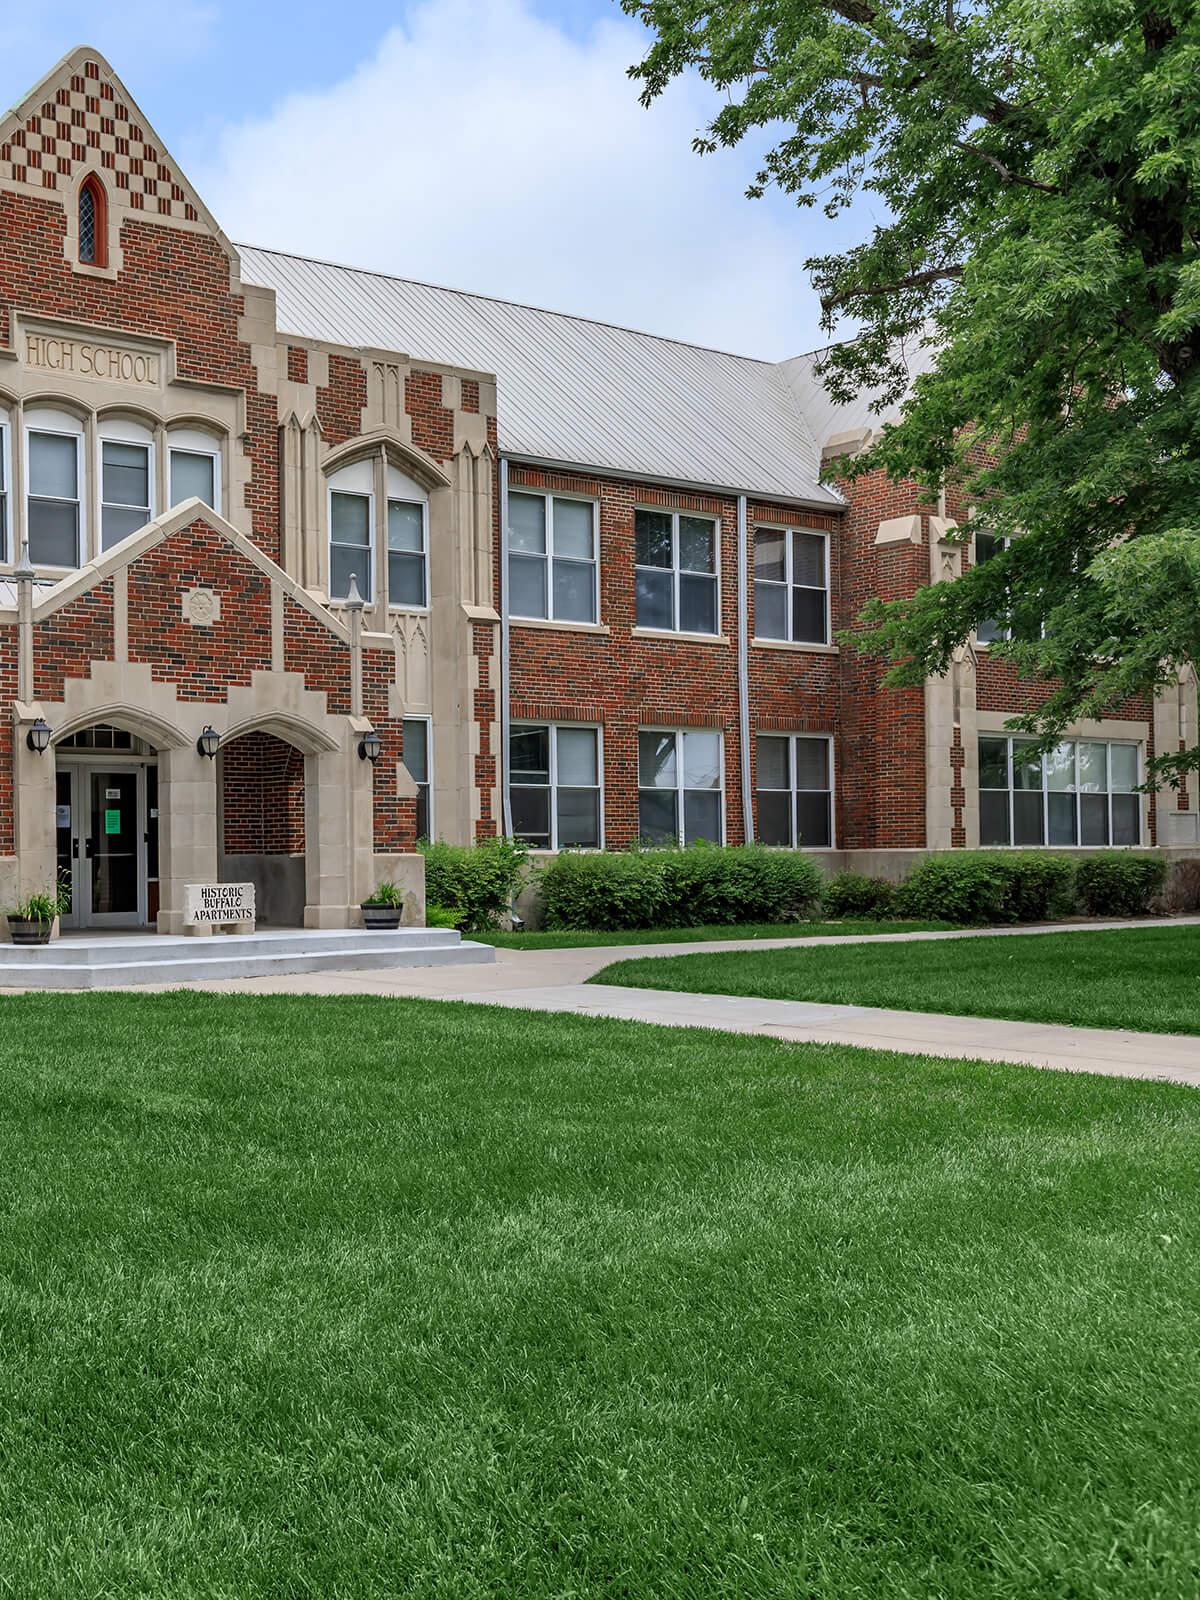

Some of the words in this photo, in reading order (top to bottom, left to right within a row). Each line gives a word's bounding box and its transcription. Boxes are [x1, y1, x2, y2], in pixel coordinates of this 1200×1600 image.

[26, 336, 74, 371] HIGH
[80, 346, 157, 385] SCHOOL
[201, 887, 243, 898] HISTORIC
[204, 897, 242, 908] BUFFALO
[193, 908, 253, 920] APARTMENTS
